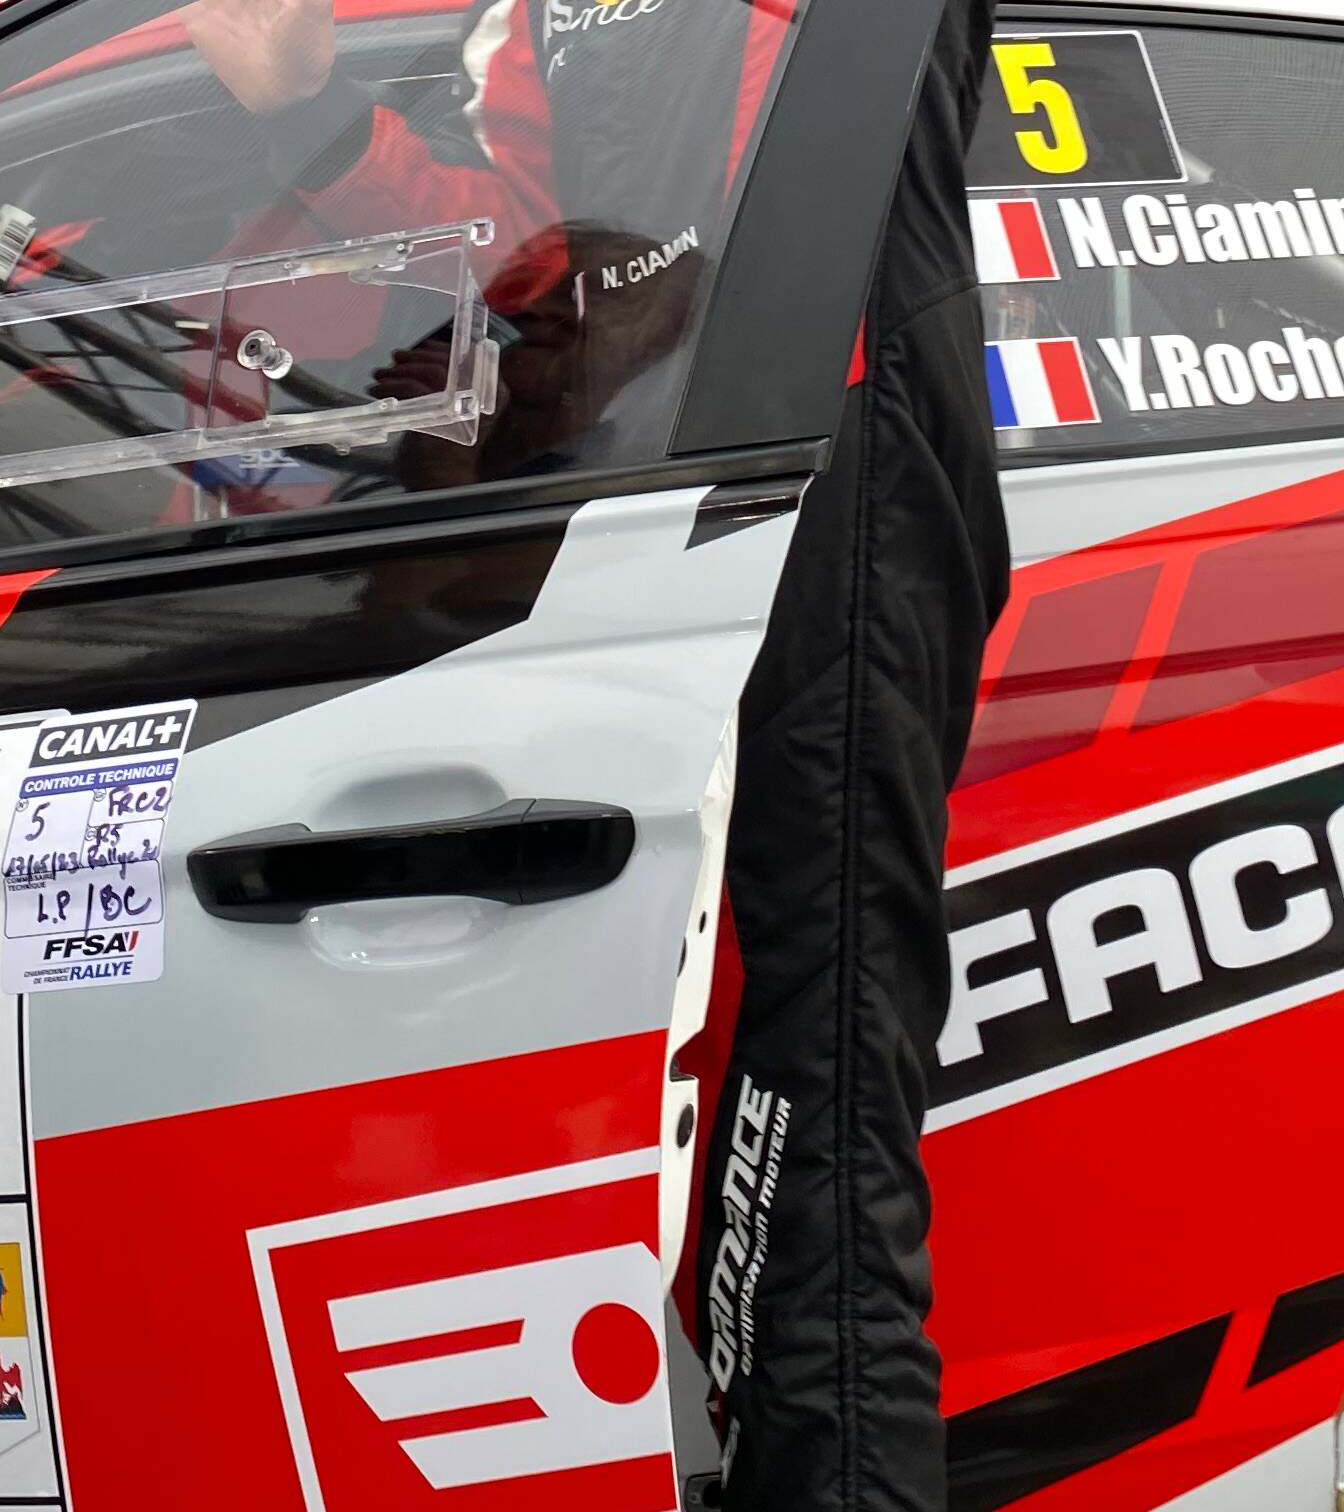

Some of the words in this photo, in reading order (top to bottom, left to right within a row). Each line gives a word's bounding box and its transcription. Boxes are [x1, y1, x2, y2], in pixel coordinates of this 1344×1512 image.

[992, 43, 1088, 174] 5
[38, 715, 183, 760] CANAL+
[25, 772, 96, 793] CONTROLE
[98, 762, 175, 784] TECHNIQUE
[25, 802, 51, 841] 5
[43, 932, 127, 961] FFSA
[69, 960, 133, 981] RALLYE
[758, 1096, 792, 1209] MOTEUR
